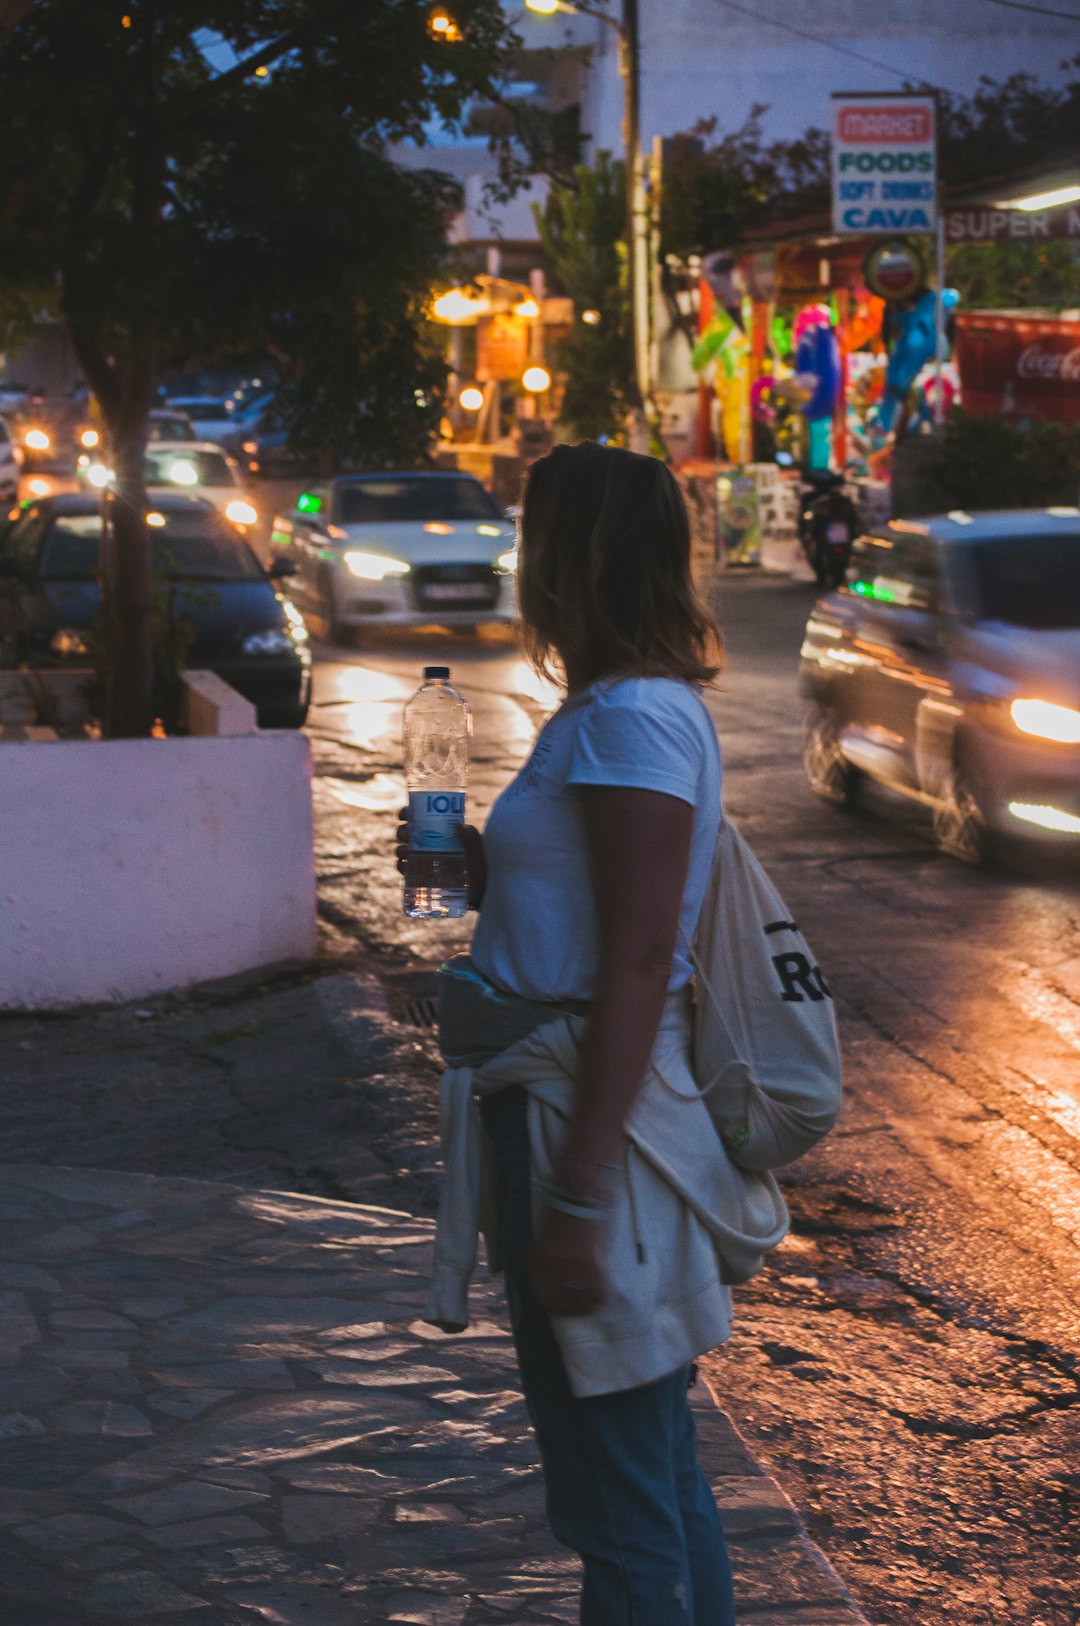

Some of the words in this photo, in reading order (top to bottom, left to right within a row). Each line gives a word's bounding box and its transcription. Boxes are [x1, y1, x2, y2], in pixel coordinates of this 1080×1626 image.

[845, 114, 924, 136] MARKET
[839, 152, 932, 173] FOODS
[843, 208, 929, 229] CAVA
[949, 212, 1049, 238] SUPER
